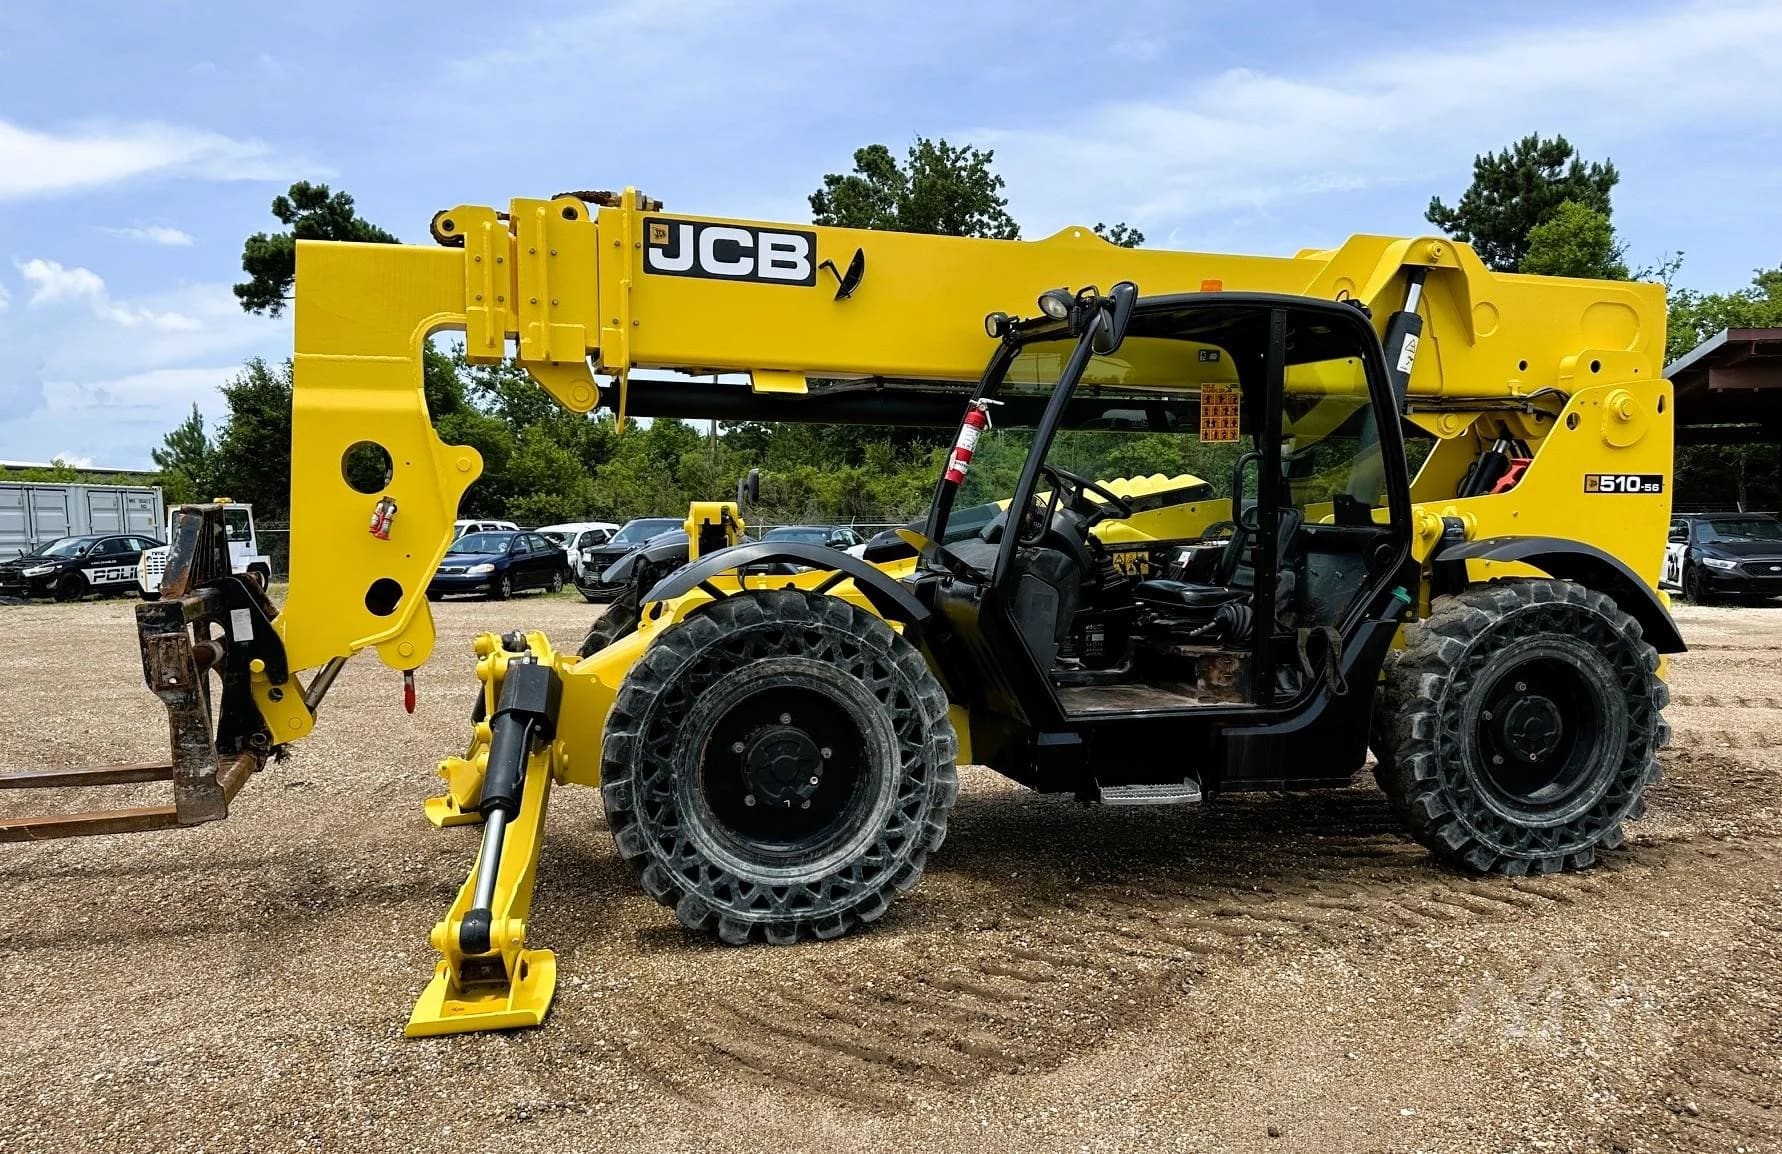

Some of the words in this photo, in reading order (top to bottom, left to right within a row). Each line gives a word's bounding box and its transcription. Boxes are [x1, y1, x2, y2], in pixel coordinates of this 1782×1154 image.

[648, 224, 811, 281] JCB
[1600, 475, 1659, 492] 510-56
[93, 566, 138, 582] POLI
